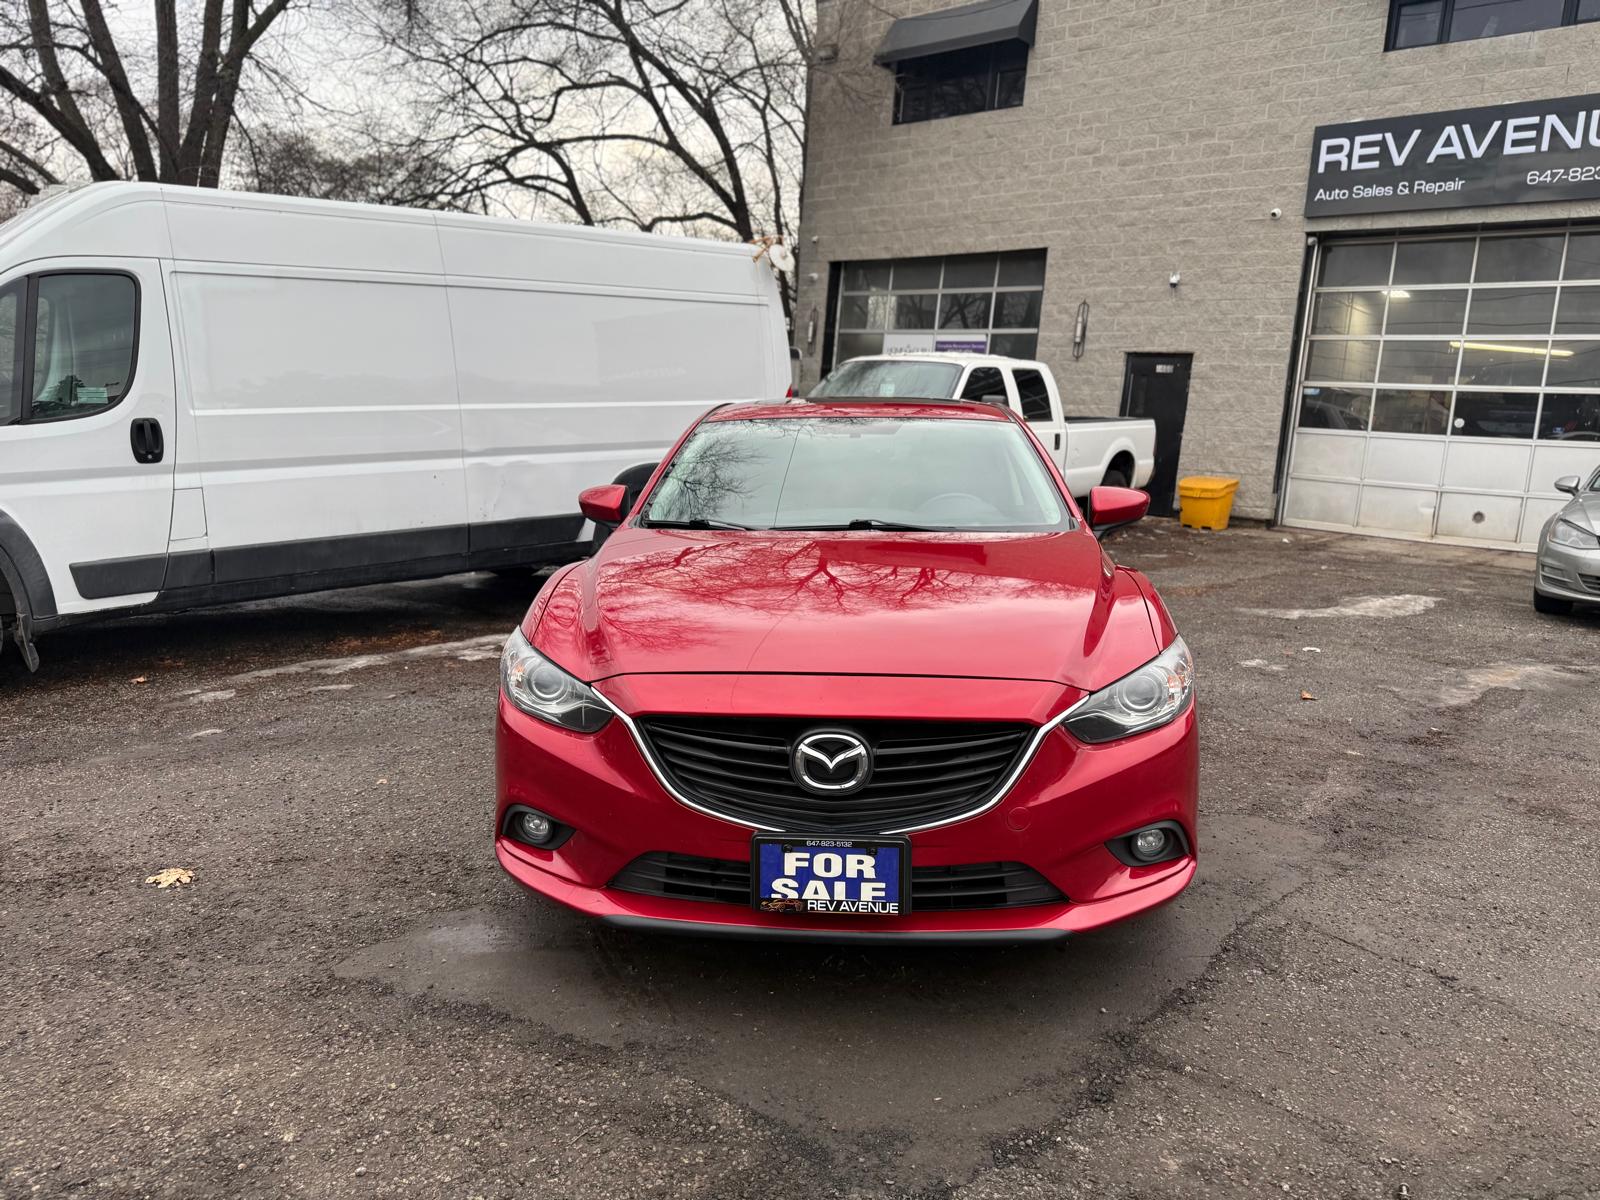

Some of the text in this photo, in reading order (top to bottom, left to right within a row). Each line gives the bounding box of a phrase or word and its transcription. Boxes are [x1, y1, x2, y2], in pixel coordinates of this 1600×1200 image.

[1317, 129, 1421, 173] REV
[1314, 178, 1465, 201] Auto Sales & Repair
[806, 840, 853, 848] 647-823-5132
[784, 852, 876, 878] FOR
[771, 878, 886, 902] SALE
[807, 900, 899, 914] REV AVENUE
